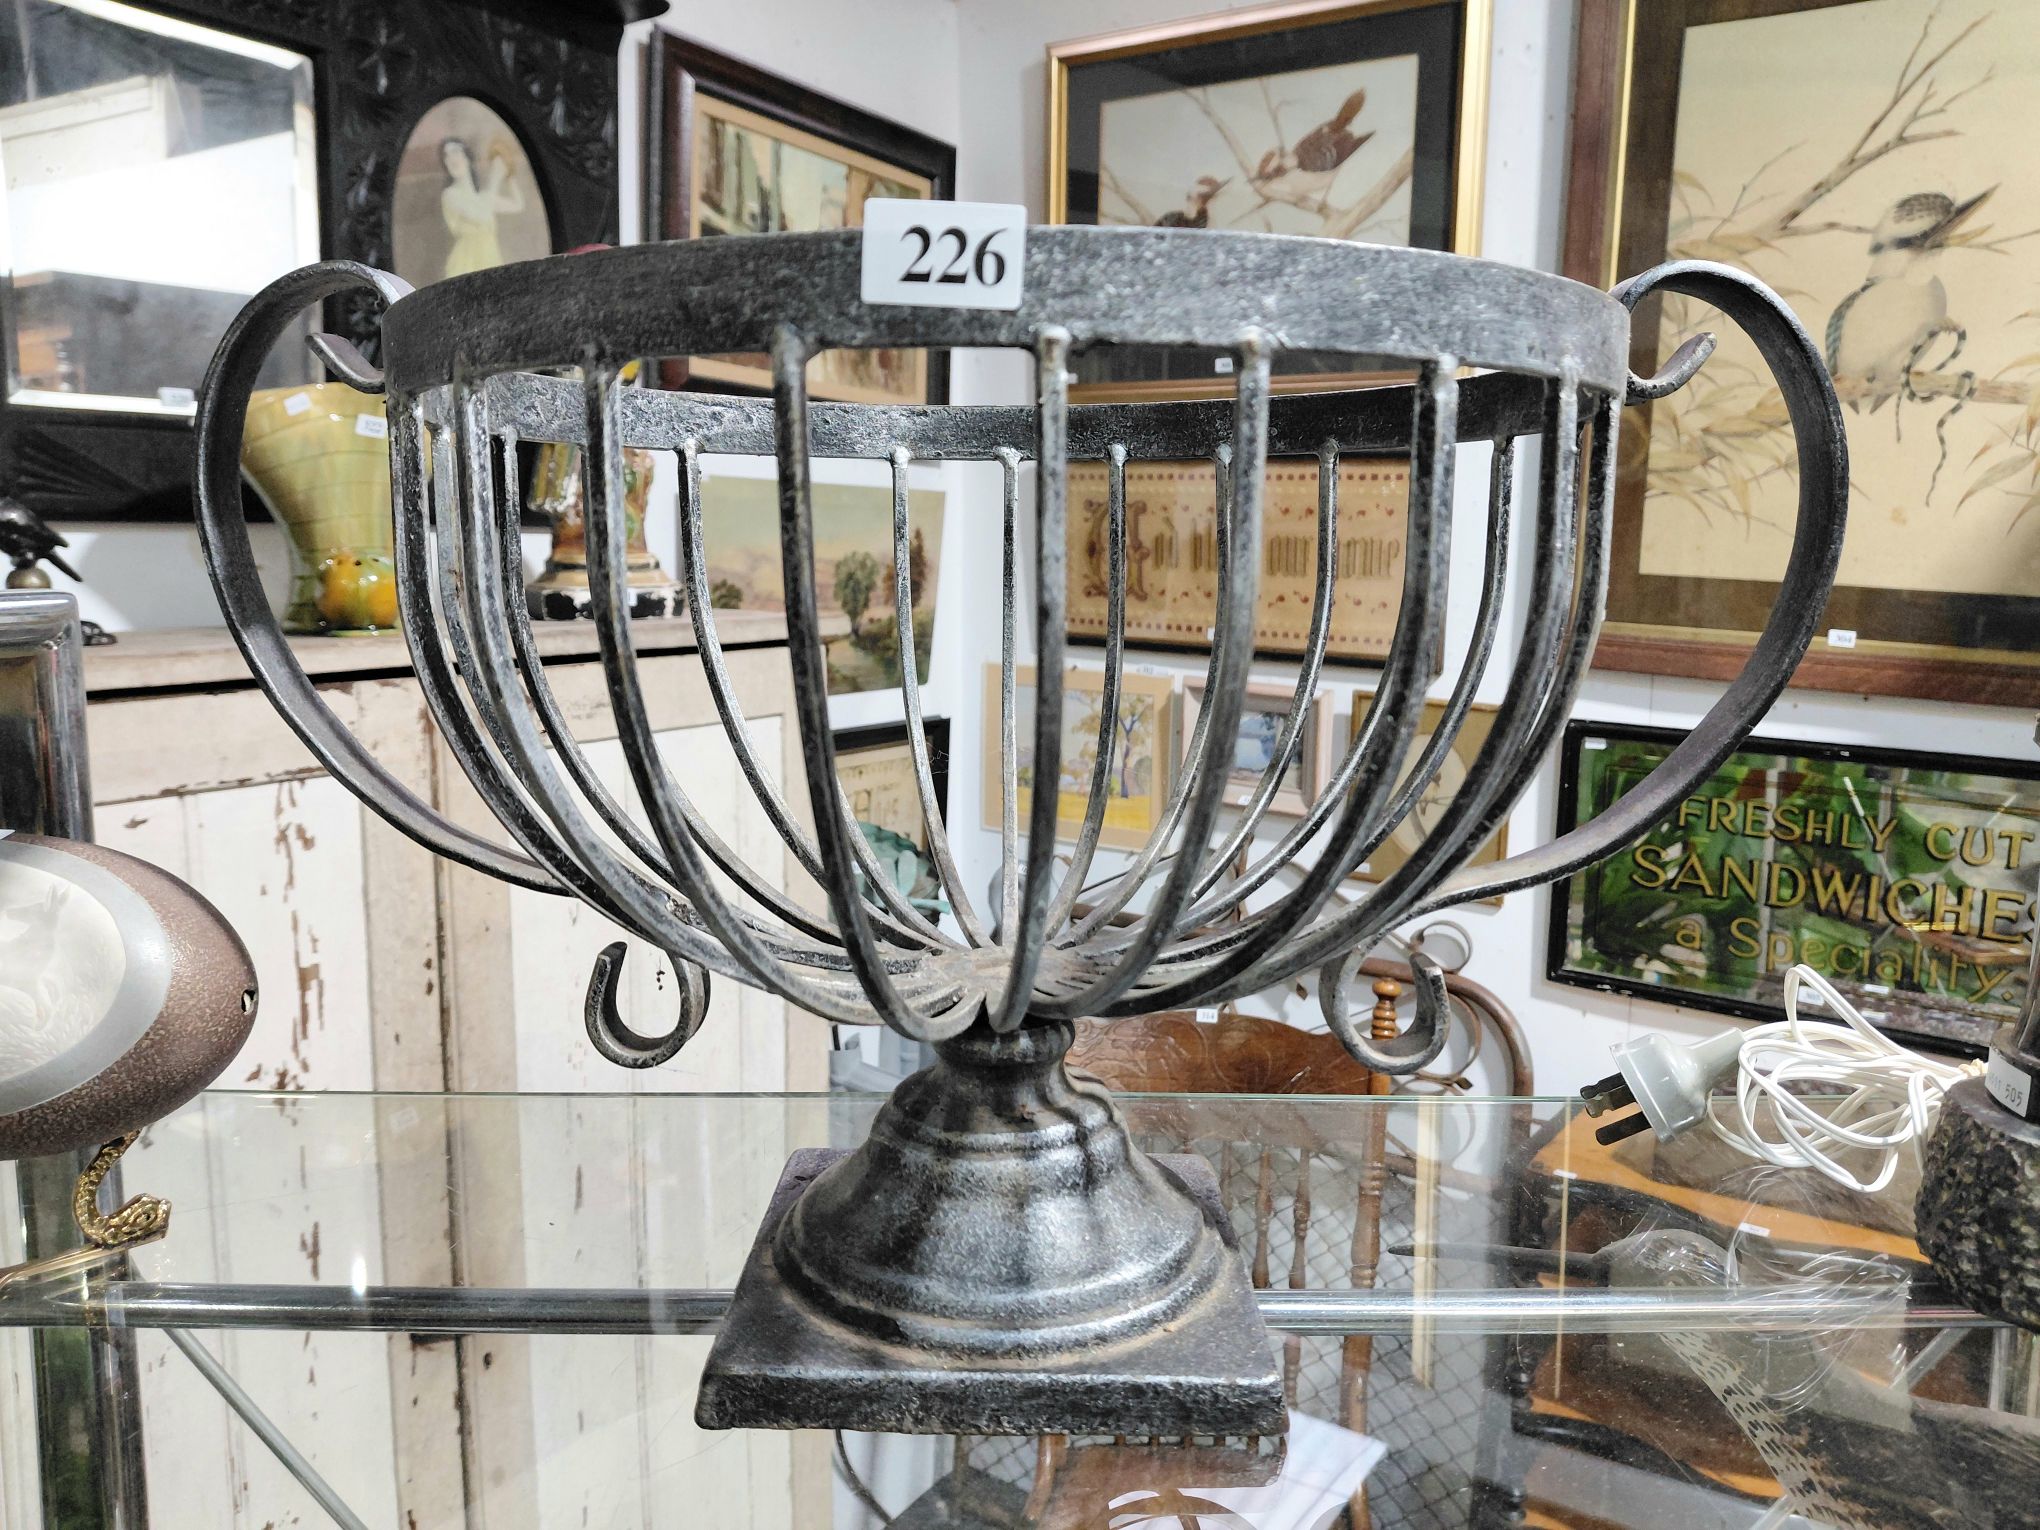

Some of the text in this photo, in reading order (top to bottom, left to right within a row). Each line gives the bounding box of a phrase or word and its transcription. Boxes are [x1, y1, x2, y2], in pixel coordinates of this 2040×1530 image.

[898, 224, 1009, 287] 226
[1678, 797, 2035, 870] FRESHLY CUT
[1675, 917, 2014, 1004] a Speciality.
